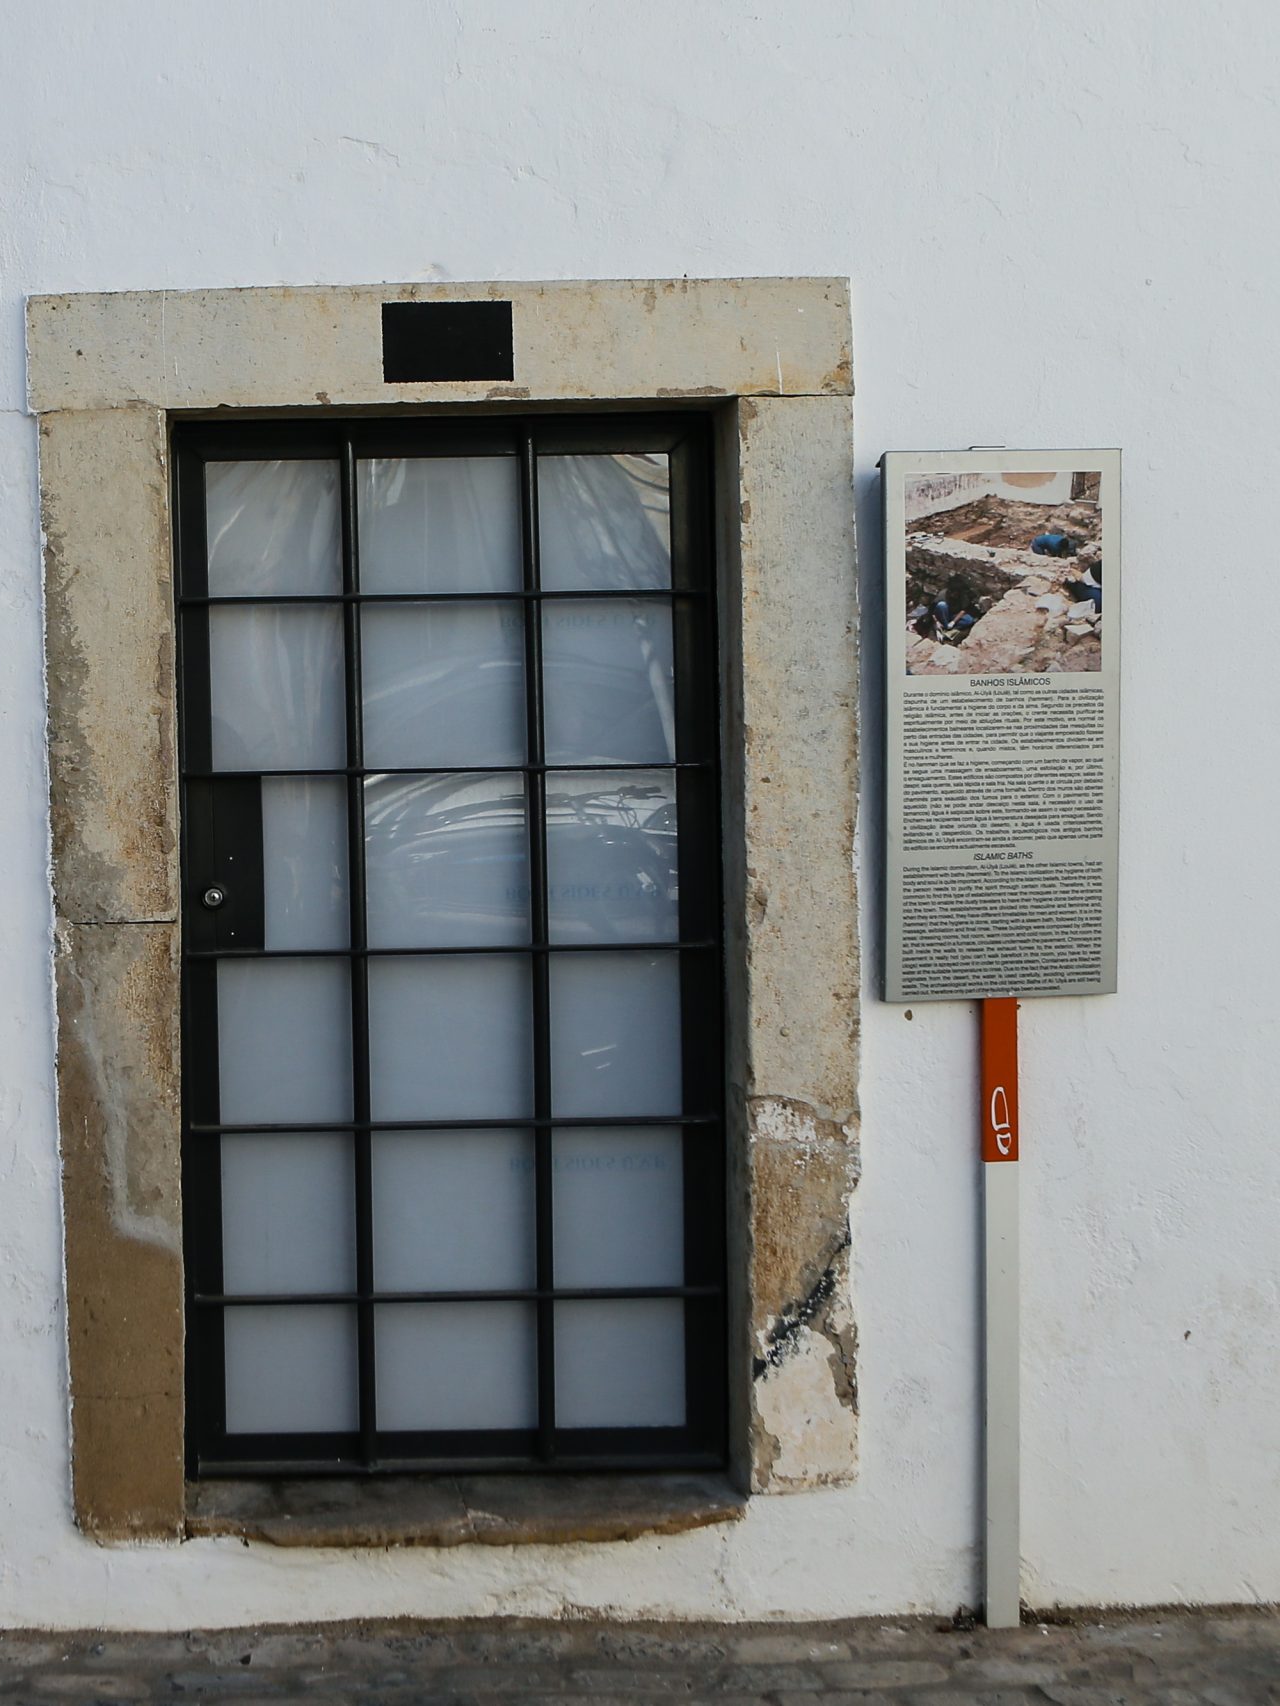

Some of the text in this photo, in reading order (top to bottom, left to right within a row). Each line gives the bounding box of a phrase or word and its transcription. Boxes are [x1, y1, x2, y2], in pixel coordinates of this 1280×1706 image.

[970, 676, 1050, 686] BANHOS ISLÂMICOS
[973, 851, 1033, 860] ISLAMIC BATHS
